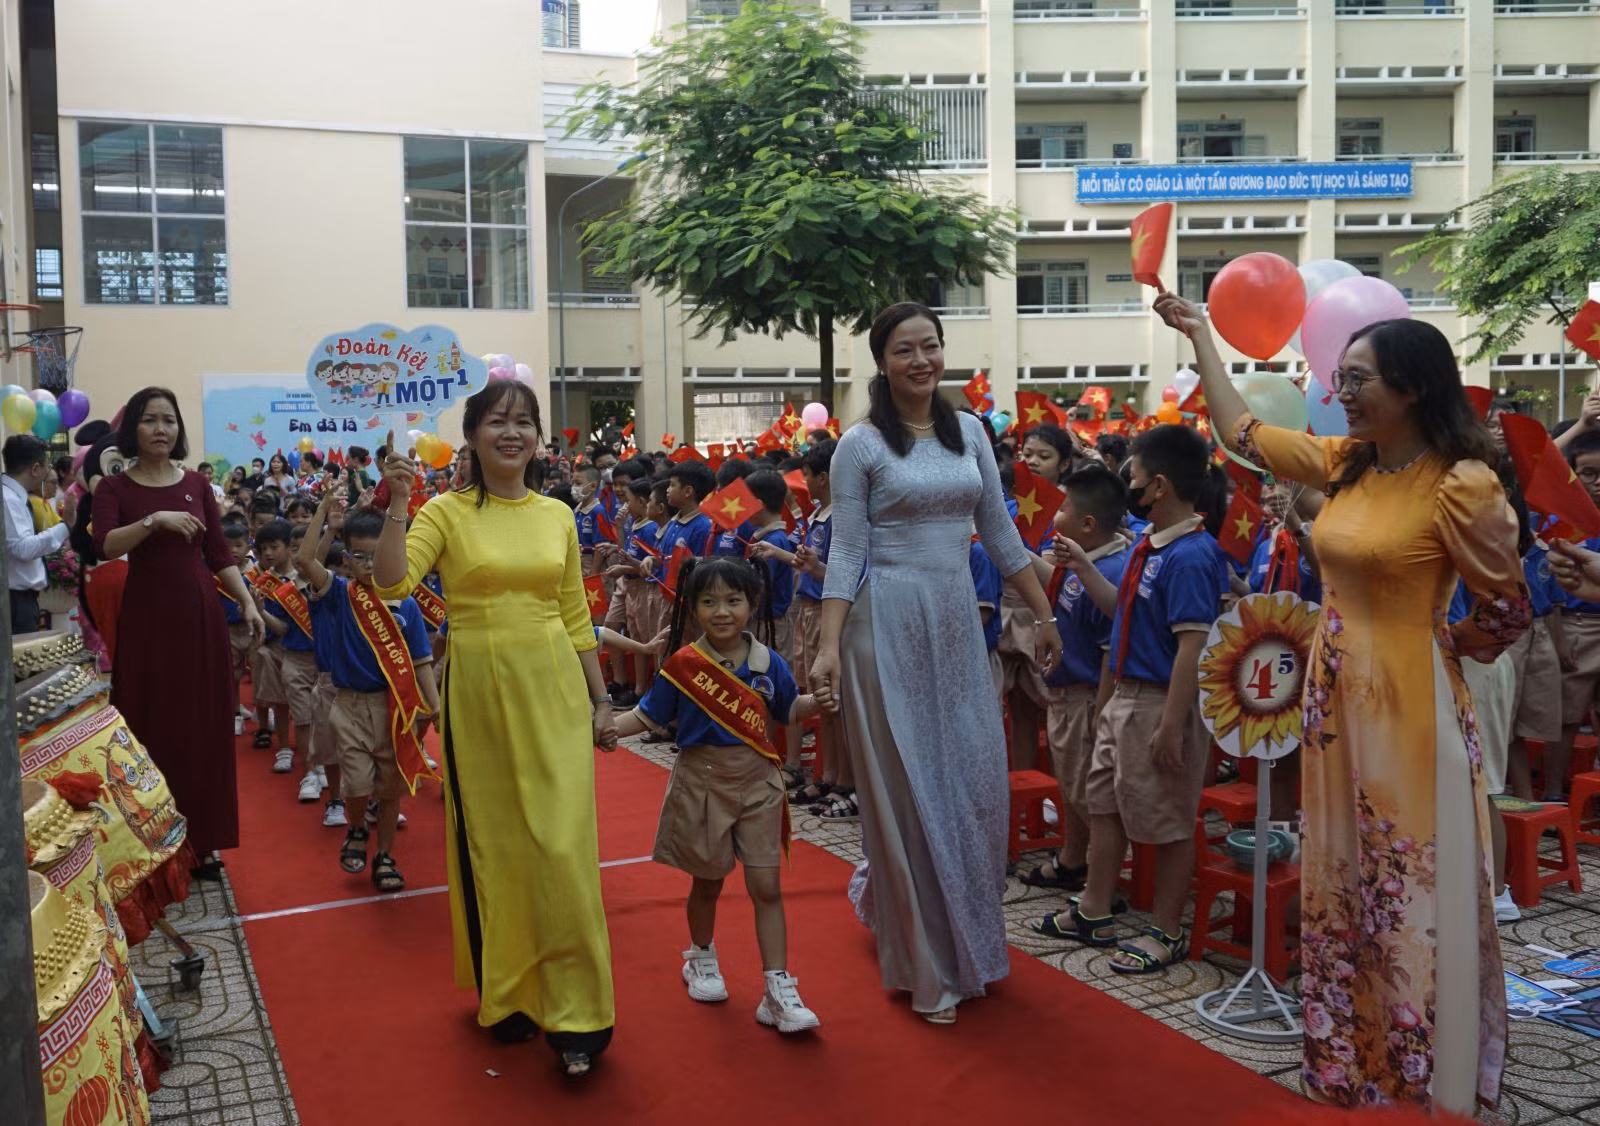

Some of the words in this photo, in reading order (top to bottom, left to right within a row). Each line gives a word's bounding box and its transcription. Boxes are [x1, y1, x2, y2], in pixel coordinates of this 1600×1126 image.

[1082, 172, 1101, 192] MỖI
[1103, 171, 1126, 192] THẦY
[1128, 173, 1143, 192] CÔ
[1146, 173, 1171, 191] GIÁO
[1172, 173, 1184, 191] LÀ
[1186, 173, 1209, 194] MỘT
[1208, 170, 1228, 190] TẤM
[1229, 174, 1264, 190] GƯƠNG
[1266, 174, 1288, 193] ĐẠO
[1288, 171, 1310, 189] ĐỨC
[1311, 173, 1323, 192] TỰ
[1324, 174, 1346, 192] HỌC
[1347, 170, 1361, 189] VÀ
[1361, 170, 1388, 188] SÁNG
[1390, 173, 1409, 191] TẠO
[336, 338, 392, 356] Đoàn
[396, 344, 428, 371] Kết
[396, 375, 454, 406] MỘT
[457, 369, 468, 386] 1
[289, 419, 312, 432] Em
[285, 593, 300, 609] EM
[368, 610, 391, 642] SINH
[385, 642, 405, 665] LỚP
[398, 666, 408, 675] 1
[1246, 659, 1278, 700] 4
[1278, 653, 1294, 675] 5
[691, 670, 720, 696] EM
[716, 690, 742, 714] LÀ
[740, 707, 765, 733] HỌC
